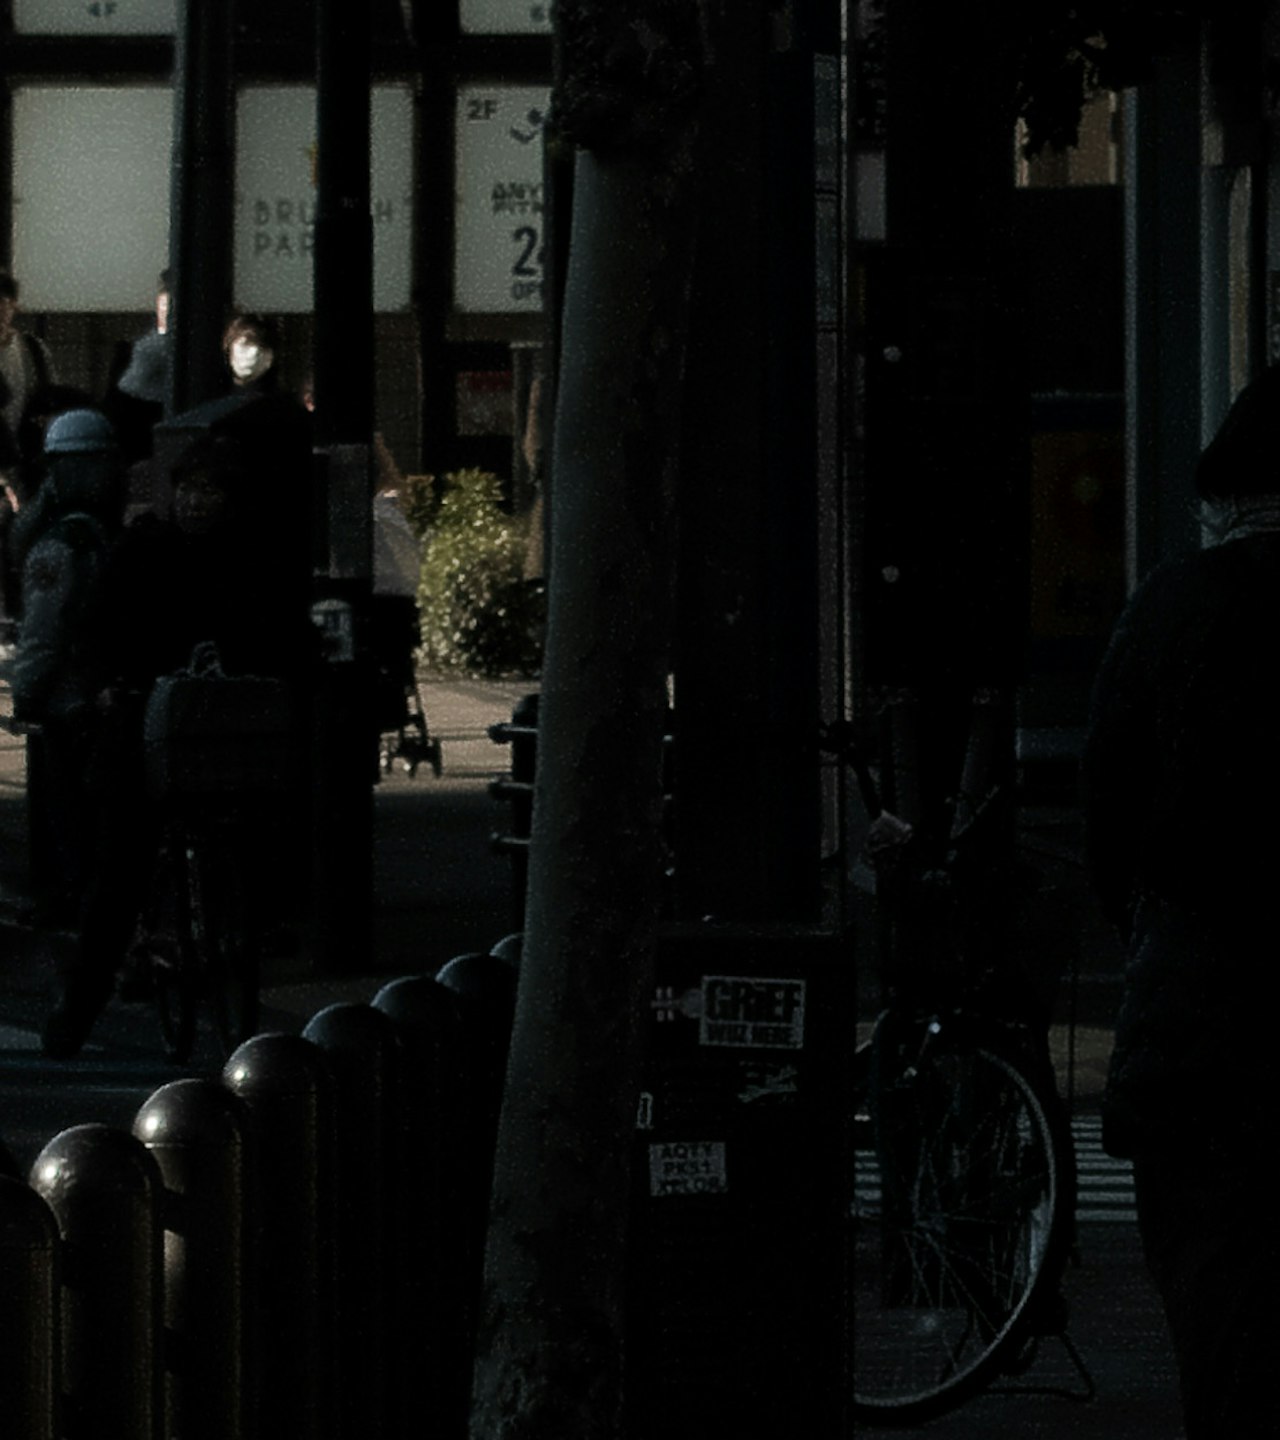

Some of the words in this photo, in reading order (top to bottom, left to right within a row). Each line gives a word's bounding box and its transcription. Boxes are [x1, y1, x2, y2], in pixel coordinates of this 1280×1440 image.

[467, 100, 498, 120] 2F
[254, 198, 393, 226] BRUH
[512, 226, 544, 276] 2
